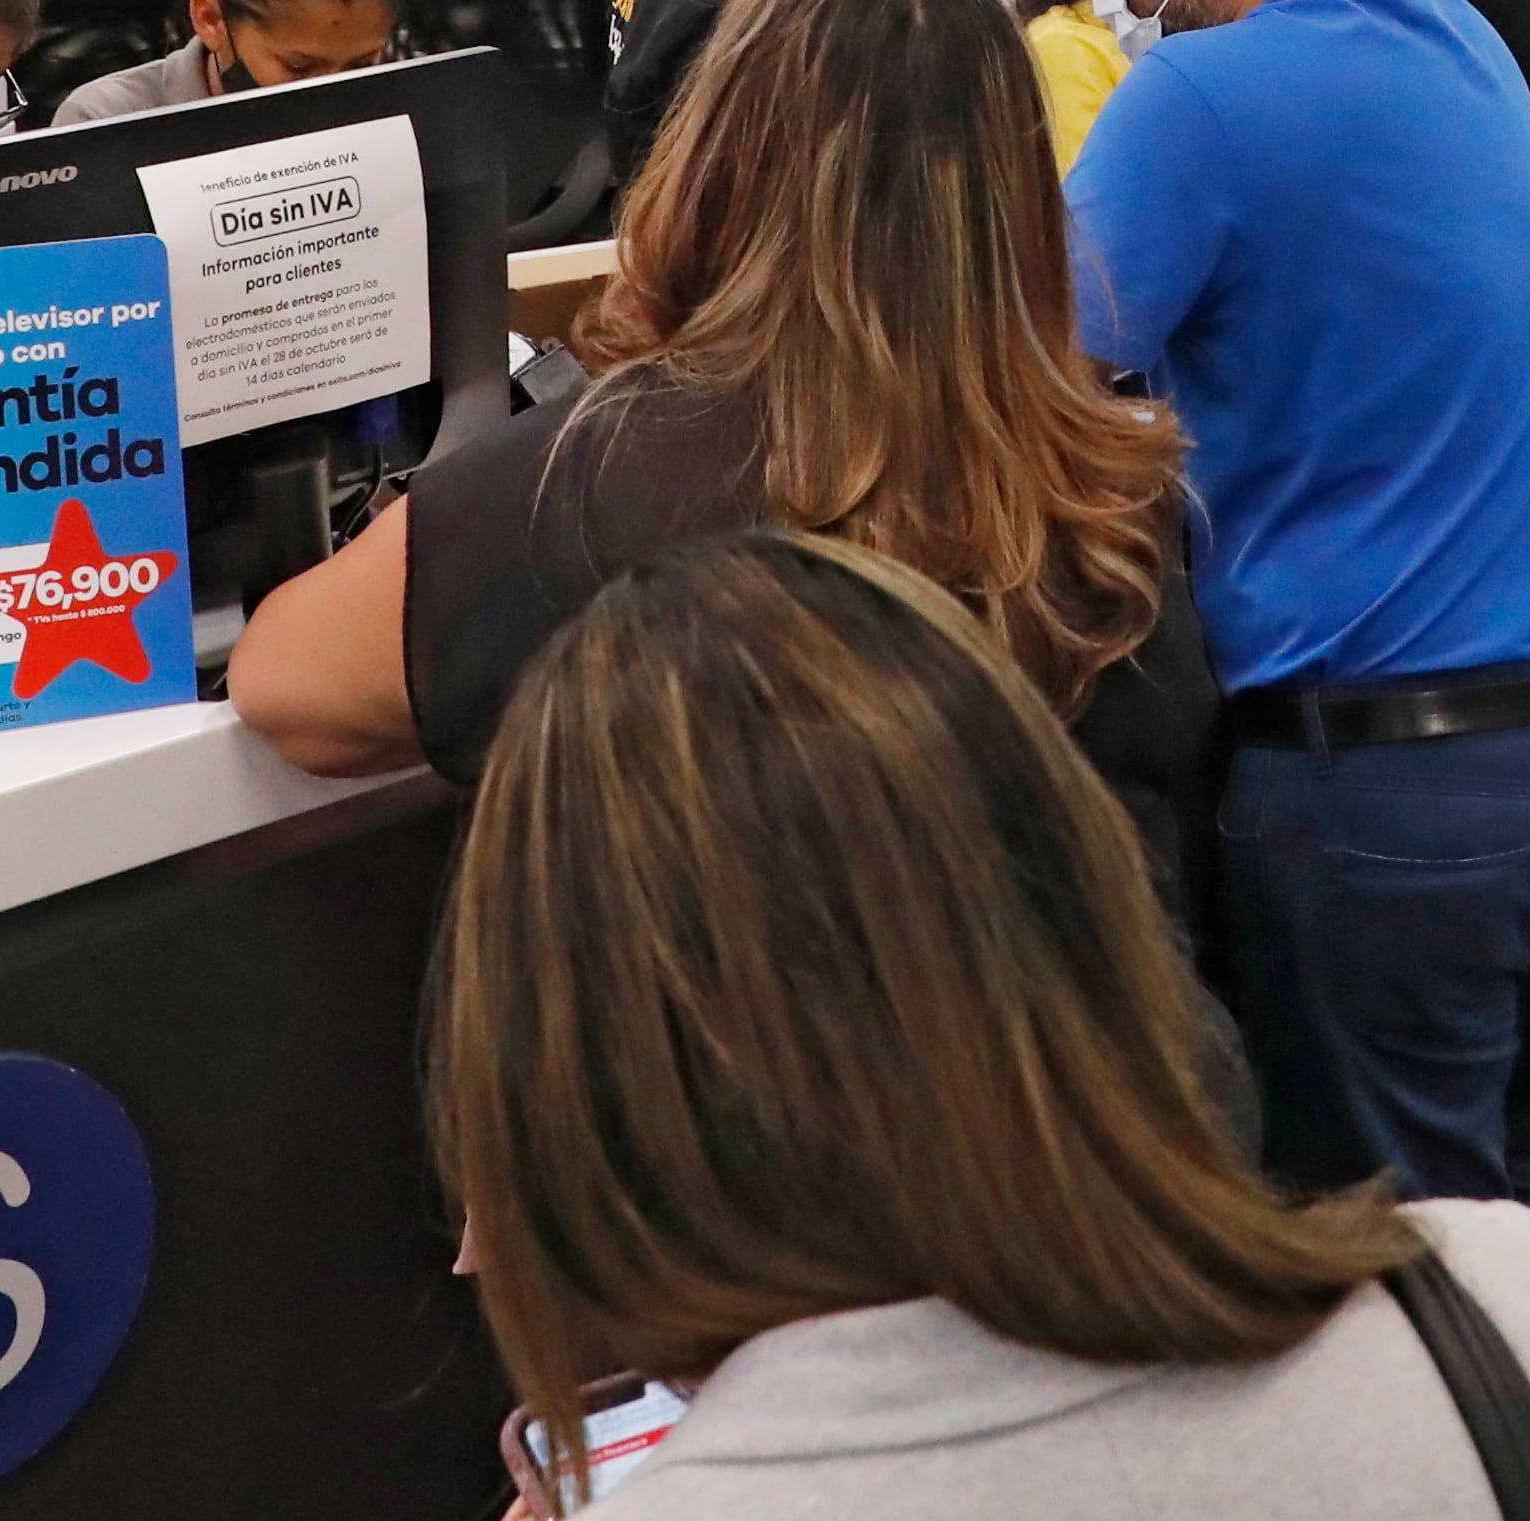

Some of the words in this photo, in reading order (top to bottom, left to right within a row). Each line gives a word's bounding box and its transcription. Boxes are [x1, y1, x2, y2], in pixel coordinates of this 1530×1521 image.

[254, 171, 269, 183] de
[270, 160, 321, 180] exención
[324, 156, 337, 168] de
[338, 151, 360, 165] IVA
[220, 207, 264, 237] Día
[270, 198, 305, 226] sin
[310, 186, 353, 218] IVA
[202, 244, 295, 278] Información
[297, 225, 380, 255] importante
[245, 271, 282, 294] para
[285, 257, 343, 282] clientes
[111, 299, 162, 328] por
[185, 317, 293, 351] electrodomésticos
[295, 312, 316, 326] que
[317, 300, 347, 319] serán
[348, 289, 397, 311] enviados
[204, 316, 219, 329] La
[221, 303, 273, 325] promesa
[276, 297, 290, 311] de
[291, 290, 334, 309] entrega
[336, 282, 361, 299] para
[362, 278, 379, 291] los
[11, 340, 67, 364] con
[197, 366, 217, 382] día
[218, 363, 236, 378] sin
[238, 358, 258, 373] IVA
[260, 355, 271, 367] el
[272, 349, 287, 364] 28
[288, 346, 303, 360] de
[305, 337, 348, 356] octubre
[349, 331, 373, 344] será
[374, 326, 388, 338] de
[200, 342, 254, 364] domicilio
[265, 323, 330, 349] comprados
[331, 319, 344, 332] en
[346, 316, 356, 328] el
[357, 308, 394, 327] primer
[245, 373, 258, 387] 14
[260, 370, 285, 384] días
[286, 354, 347, 378] calendario
[183, 406, 222, 423] Consulta
[222, 395, 259, 414] términos
[267, 384, 315, 402] condiciones
[52, 610, 79, 623] hasta
